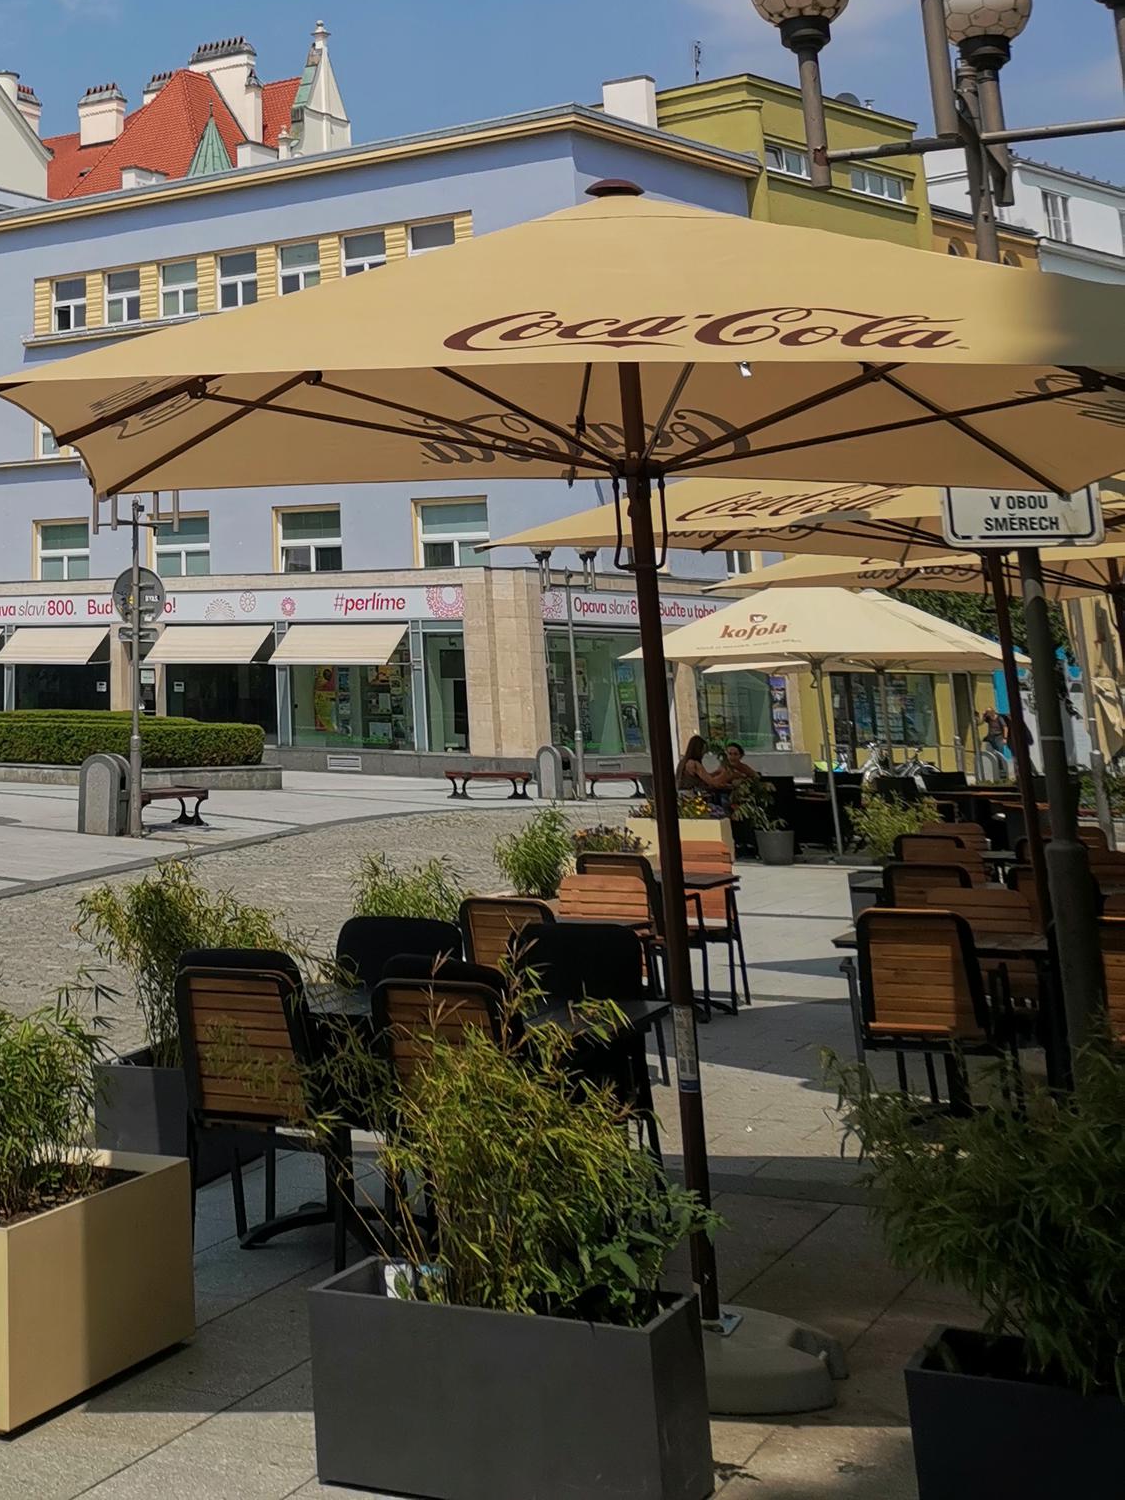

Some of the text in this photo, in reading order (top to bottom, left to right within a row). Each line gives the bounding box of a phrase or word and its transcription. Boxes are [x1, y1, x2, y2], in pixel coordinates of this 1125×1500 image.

[442, 307, 966, 352] Coca-Cola
[990, 495, 1048, 510] V OBOU
[984, 513, 1060, 531] SMĚRECH
[18, 600, 47, 617] slaví
[333, 592, 406, 616] #perlíme
[574, 597, 607, 617] Opava
[687, 607, 693, 618] u
[719, 623, 787, 640] kofola
